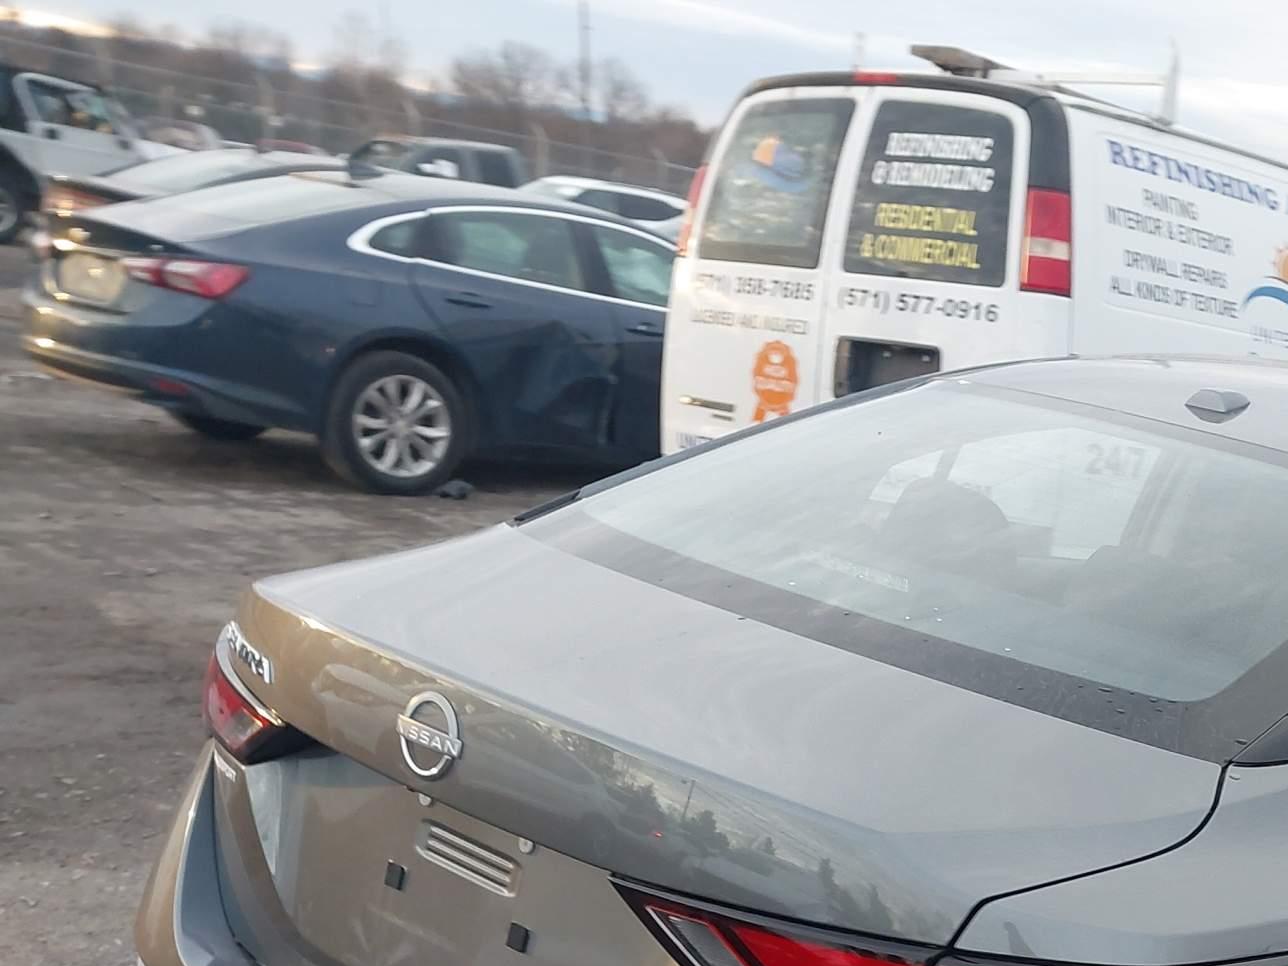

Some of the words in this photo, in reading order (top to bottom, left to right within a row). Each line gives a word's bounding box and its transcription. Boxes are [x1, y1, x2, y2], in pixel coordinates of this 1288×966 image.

[1107, 139, 1279, 211] REFINISHING
[838, 286, 891, 315] (571)
[896, 292, 1000, 323] 577-0916
[1110, 275, 1135, 297] ALL
